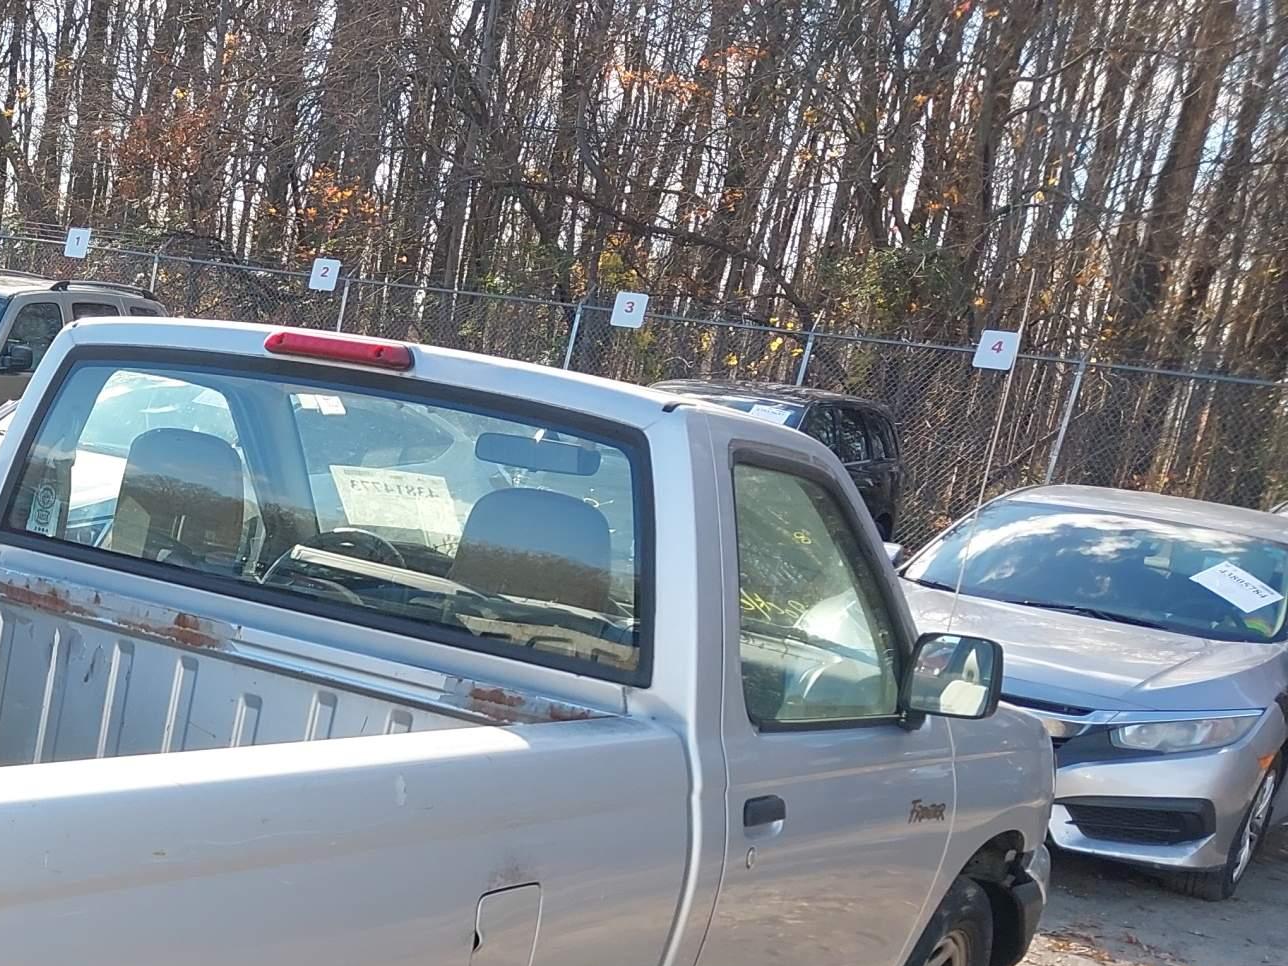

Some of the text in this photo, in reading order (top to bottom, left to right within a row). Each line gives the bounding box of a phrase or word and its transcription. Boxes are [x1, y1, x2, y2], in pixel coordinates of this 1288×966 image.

[75, 236, 81, 246] 1
[320, 266, 330, 278] 2
[624, 301, 635, 313] 3
[991, 340, 1004, 353] 4
